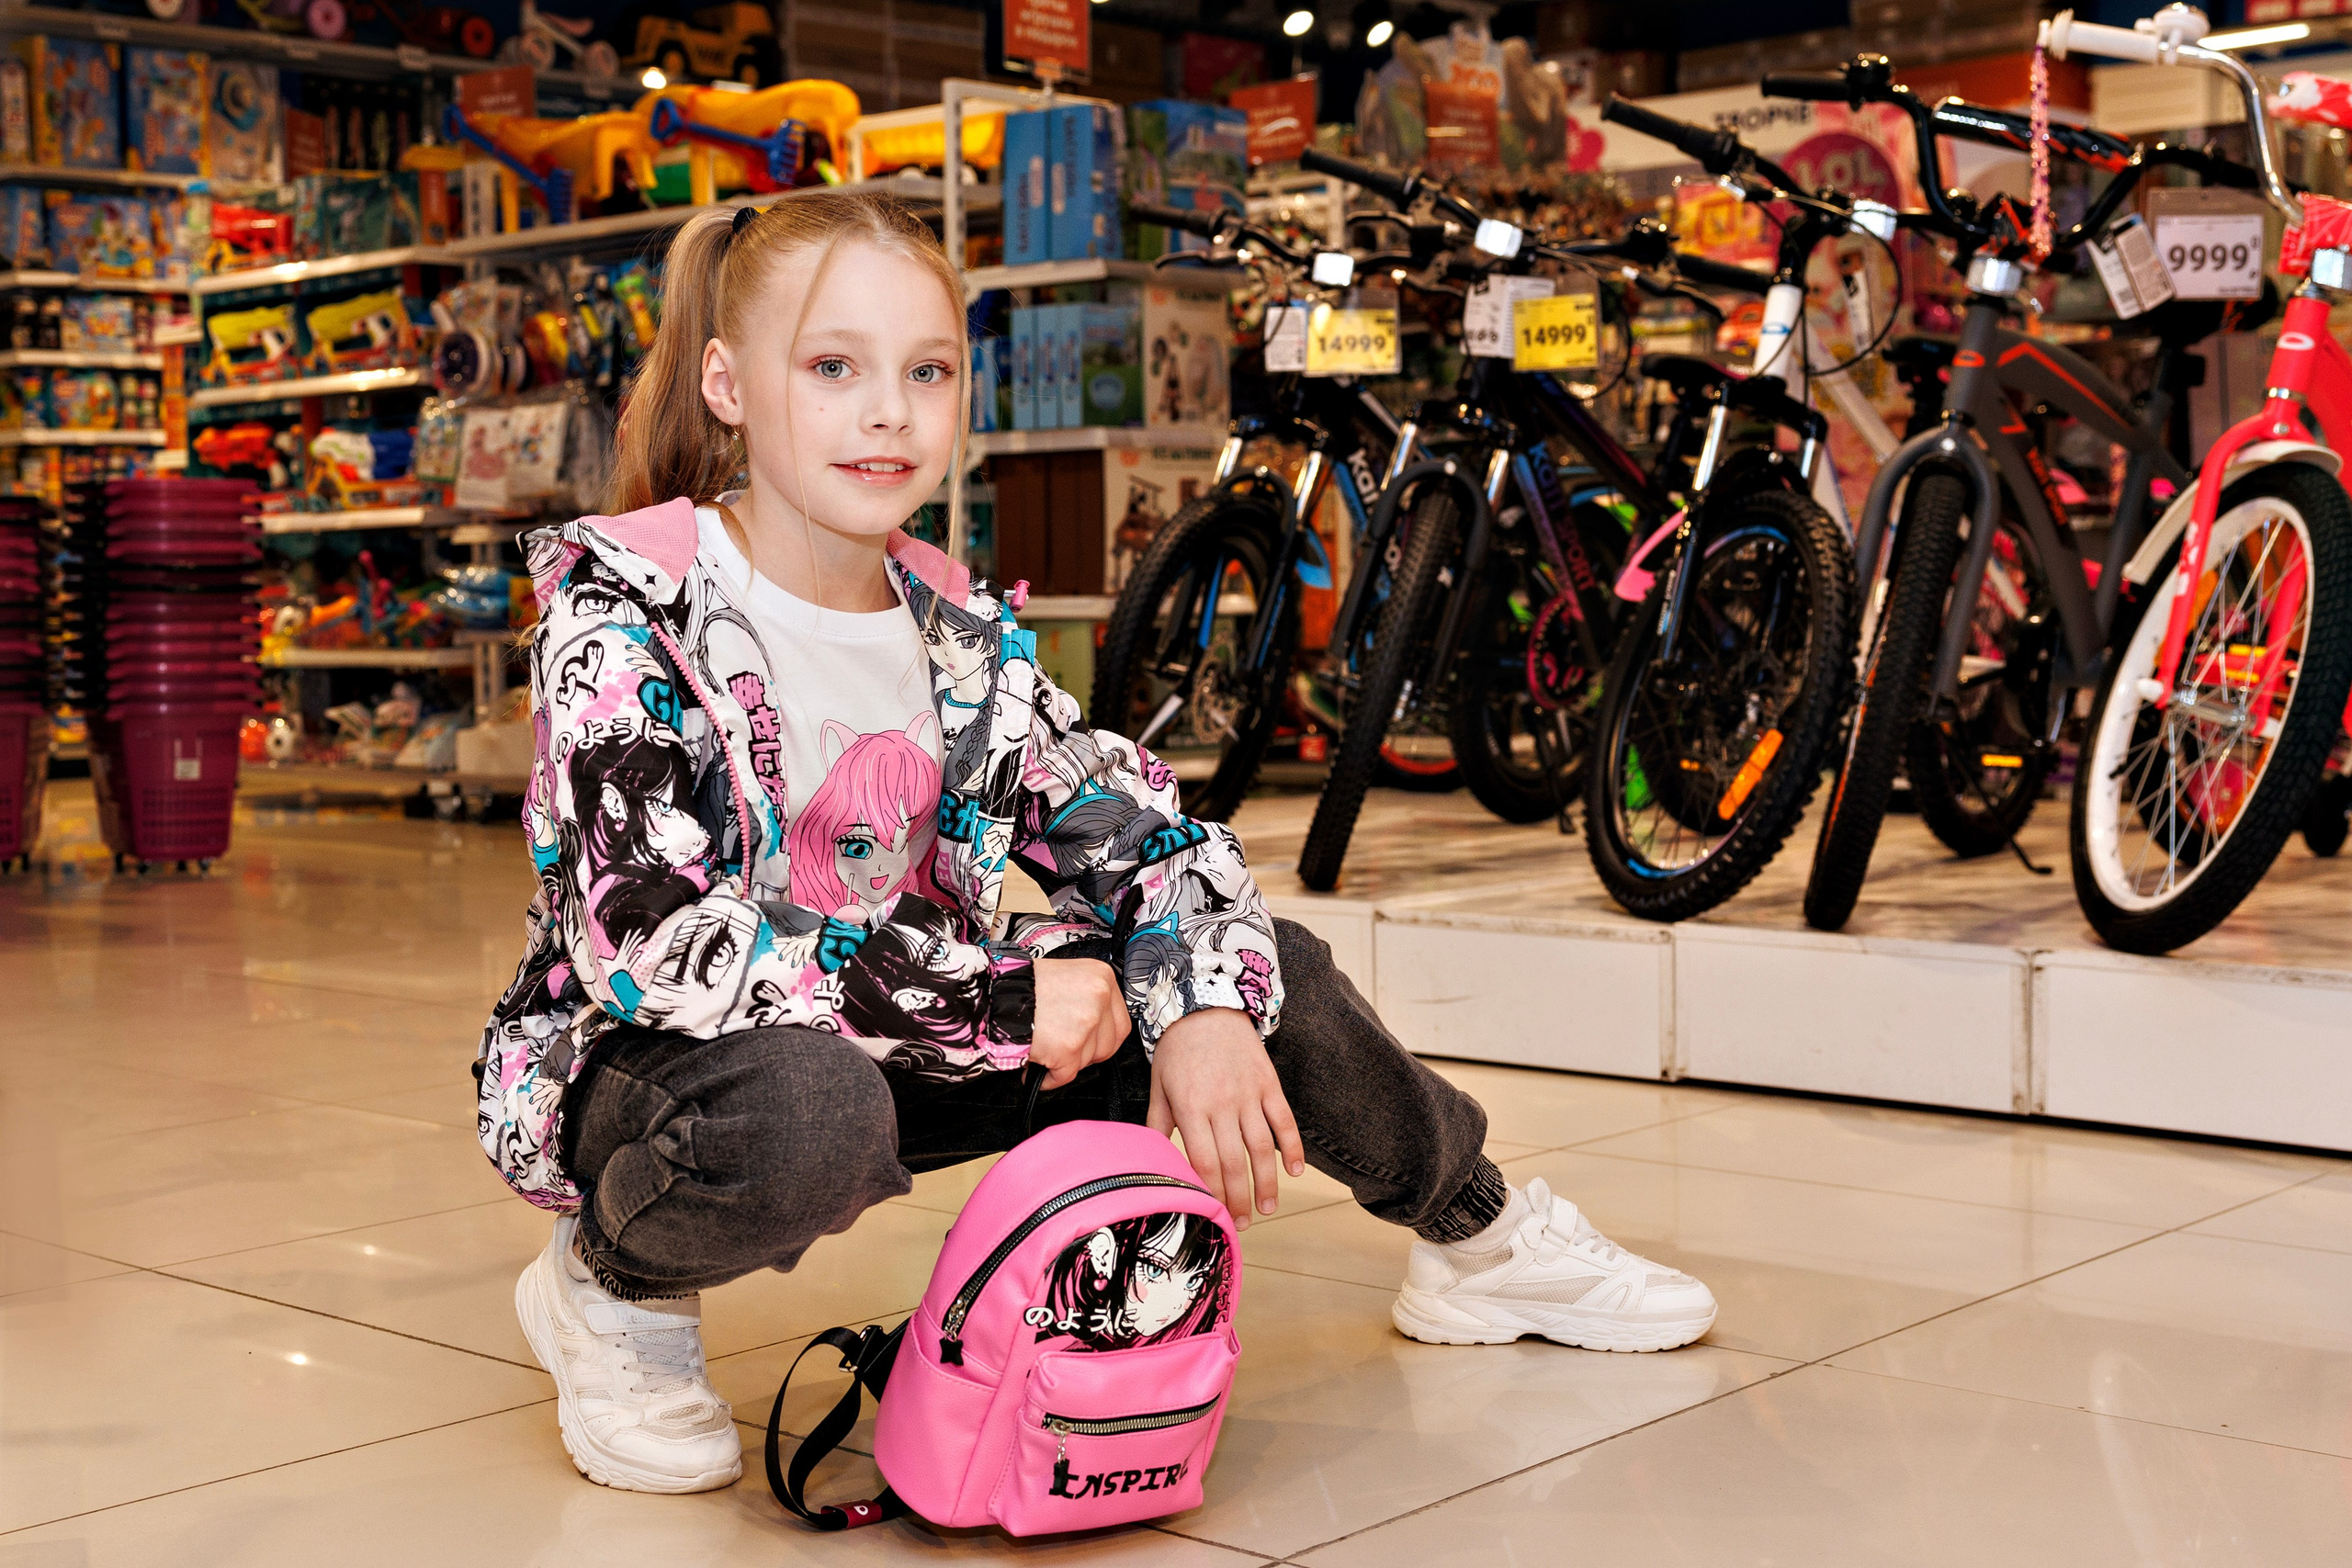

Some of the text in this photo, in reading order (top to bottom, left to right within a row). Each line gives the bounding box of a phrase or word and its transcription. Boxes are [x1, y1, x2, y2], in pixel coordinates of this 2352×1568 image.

[2169, 243, 2248, 273] 9999
[1318, 333, 1386, 353] 14999
[1523, 322, 1588, 347] 14999
[1023, 1304, 1138, 1334] のように
